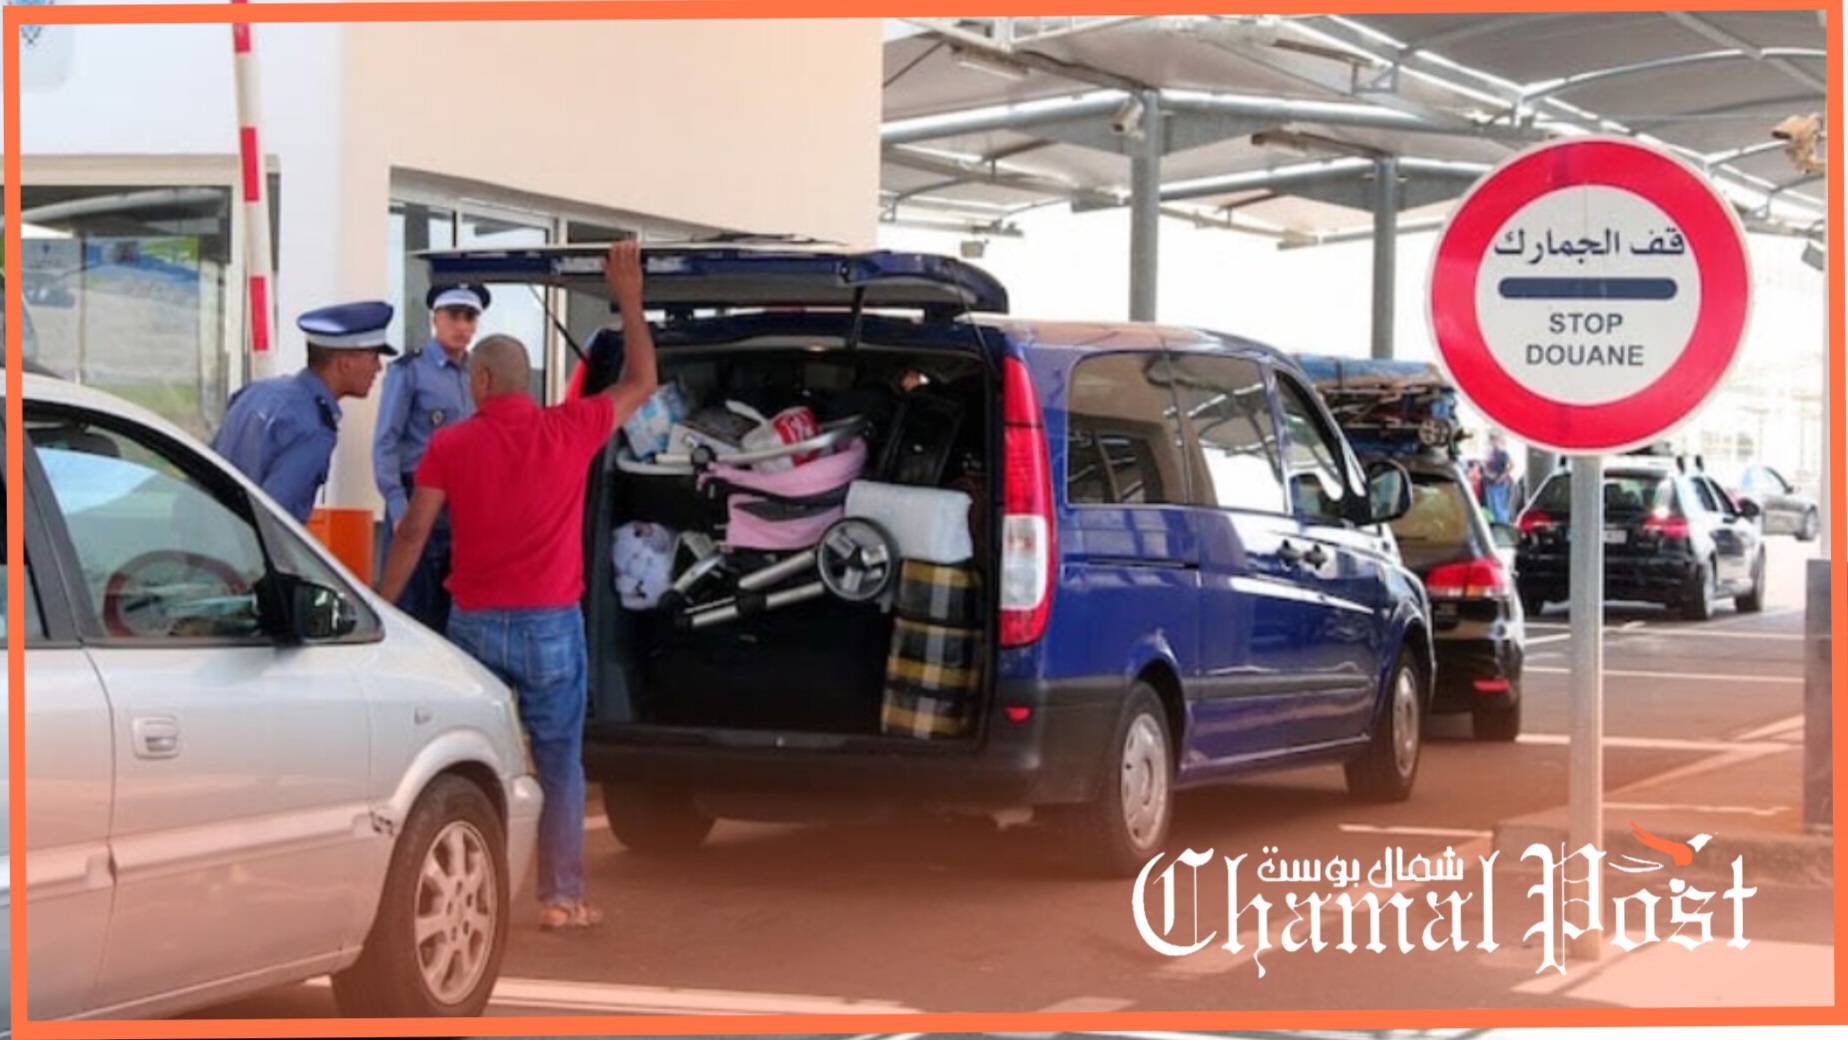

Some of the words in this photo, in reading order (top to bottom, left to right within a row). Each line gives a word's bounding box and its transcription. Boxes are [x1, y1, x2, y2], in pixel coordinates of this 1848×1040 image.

[1493, 227, 1620, 265] الجمارك
[1629, 227, 1686, 256] قف
[1549, 312, 1623, 335] STOP
[1525, 344, 1644, 366] DOUANE
